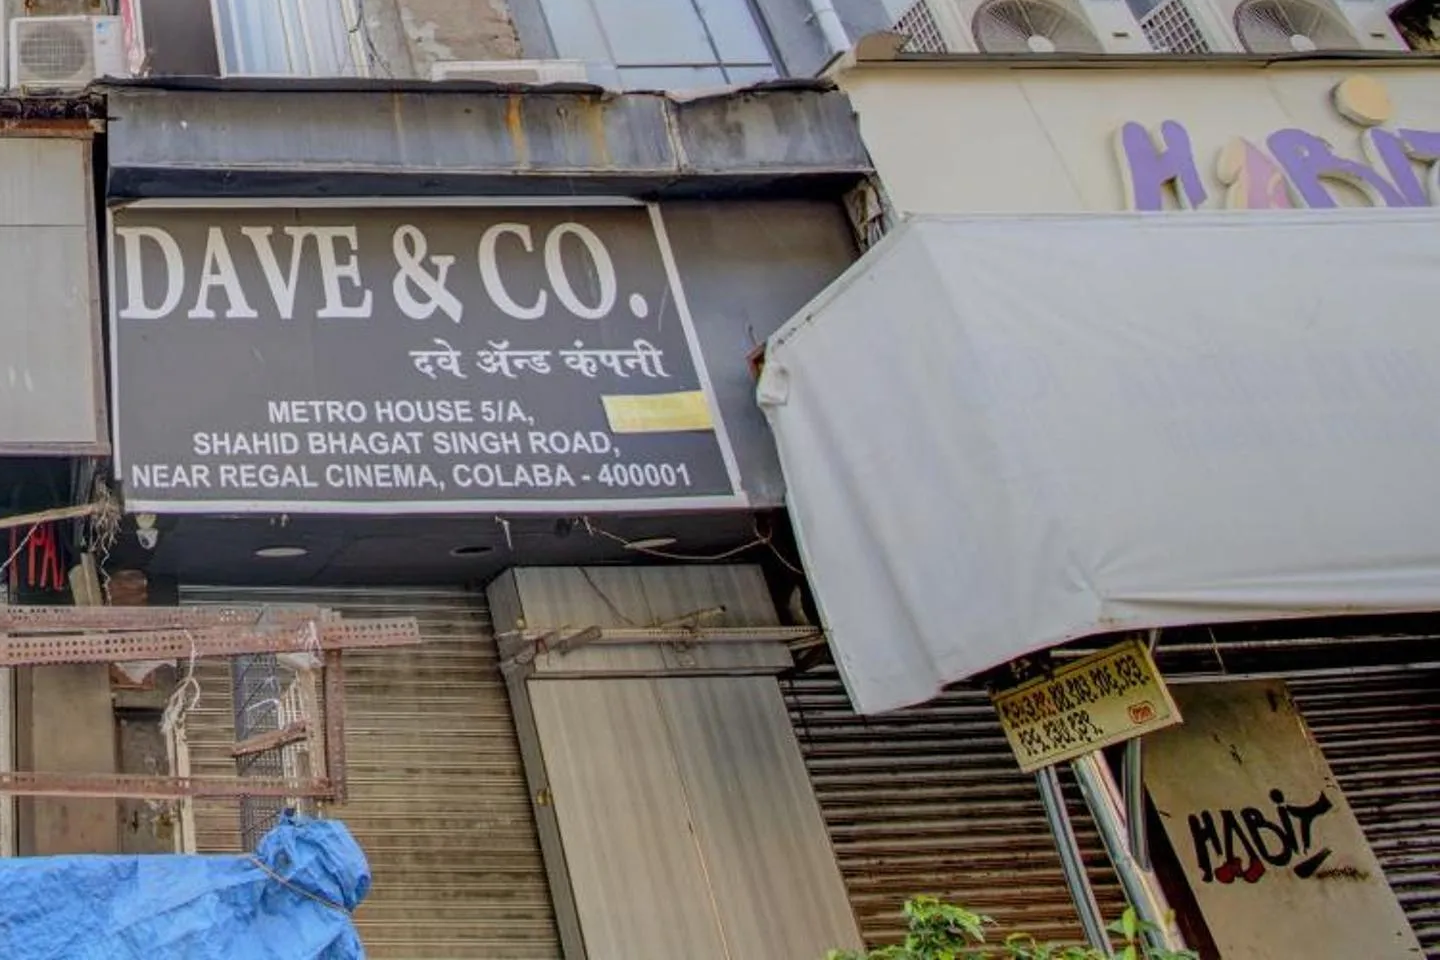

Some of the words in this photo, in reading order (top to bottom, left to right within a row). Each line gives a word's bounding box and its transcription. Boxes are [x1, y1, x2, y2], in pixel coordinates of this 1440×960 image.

[115, 226, 372, 319] DAVE
[392, 224, 463, 323] &
[478, 222, 648, 319] CO.
[409, 338, 467, 379] दवे
[559, 339, 670, 377] कंपनी
[268, 400, 367, 424] METRO
[375, 400, 473, 423] HOUSE
[193, 432, 299, 455] SHAHID
[308, 432, 423, 455] BHAGAT
[433, 431, 521, 454] SINGH
[528, 431, 620, 458] ROAD,
[132, 464, 210, 488] NEAR
[219, 464, 319, 488] REGAL
[325, 463, 445, 491] CINEMA,
[453, 463, 575, 487] COLABA
[597, 462, 691, 486] 400001
